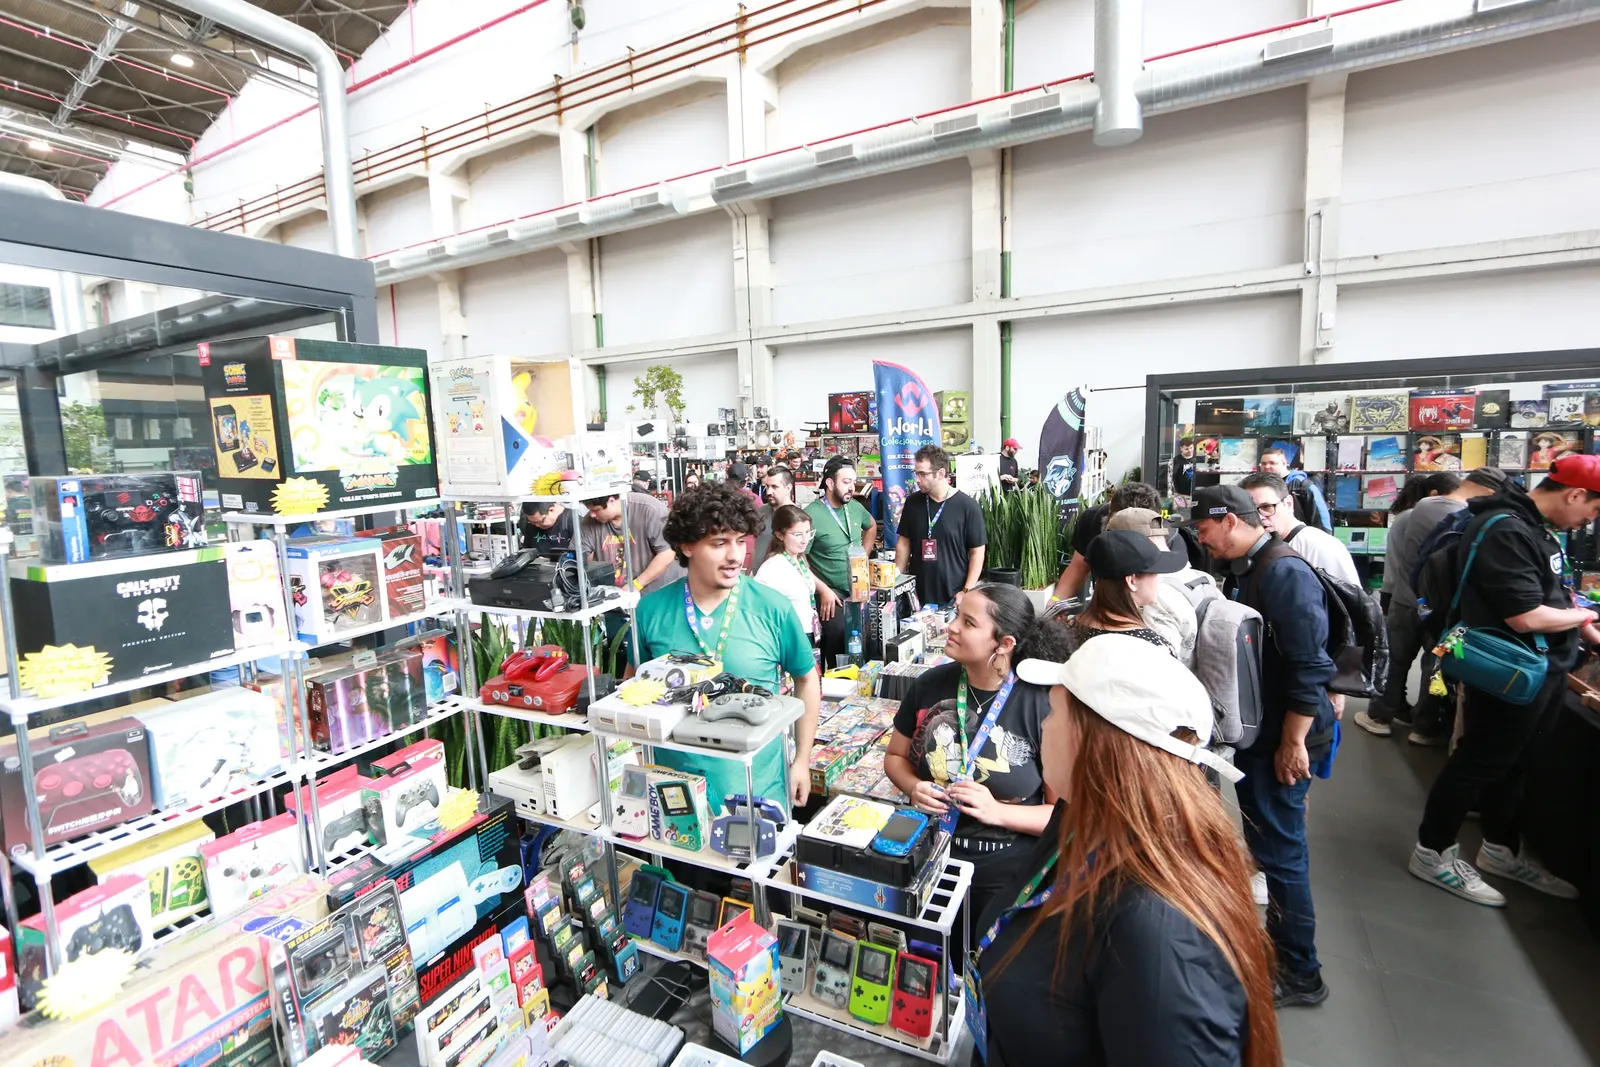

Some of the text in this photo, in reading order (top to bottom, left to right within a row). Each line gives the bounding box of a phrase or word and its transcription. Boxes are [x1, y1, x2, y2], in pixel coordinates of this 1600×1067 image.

[887, 416, 934, 438] World
[320, 548, 341, 556] PS4
[117, 581, 142, 594] CALL
[149, 575, 181, 590] DUTY
[122, 585, 178, 598] GHOSTS
[648, 783, 661, 840] GAME BOY
[816, 877, 853, 892] PSP
[420, 956, 452, 998] SUPER
[90, 935, 270, 1067] ATARI
[234, 998, 269, 1028] SYSTEM
